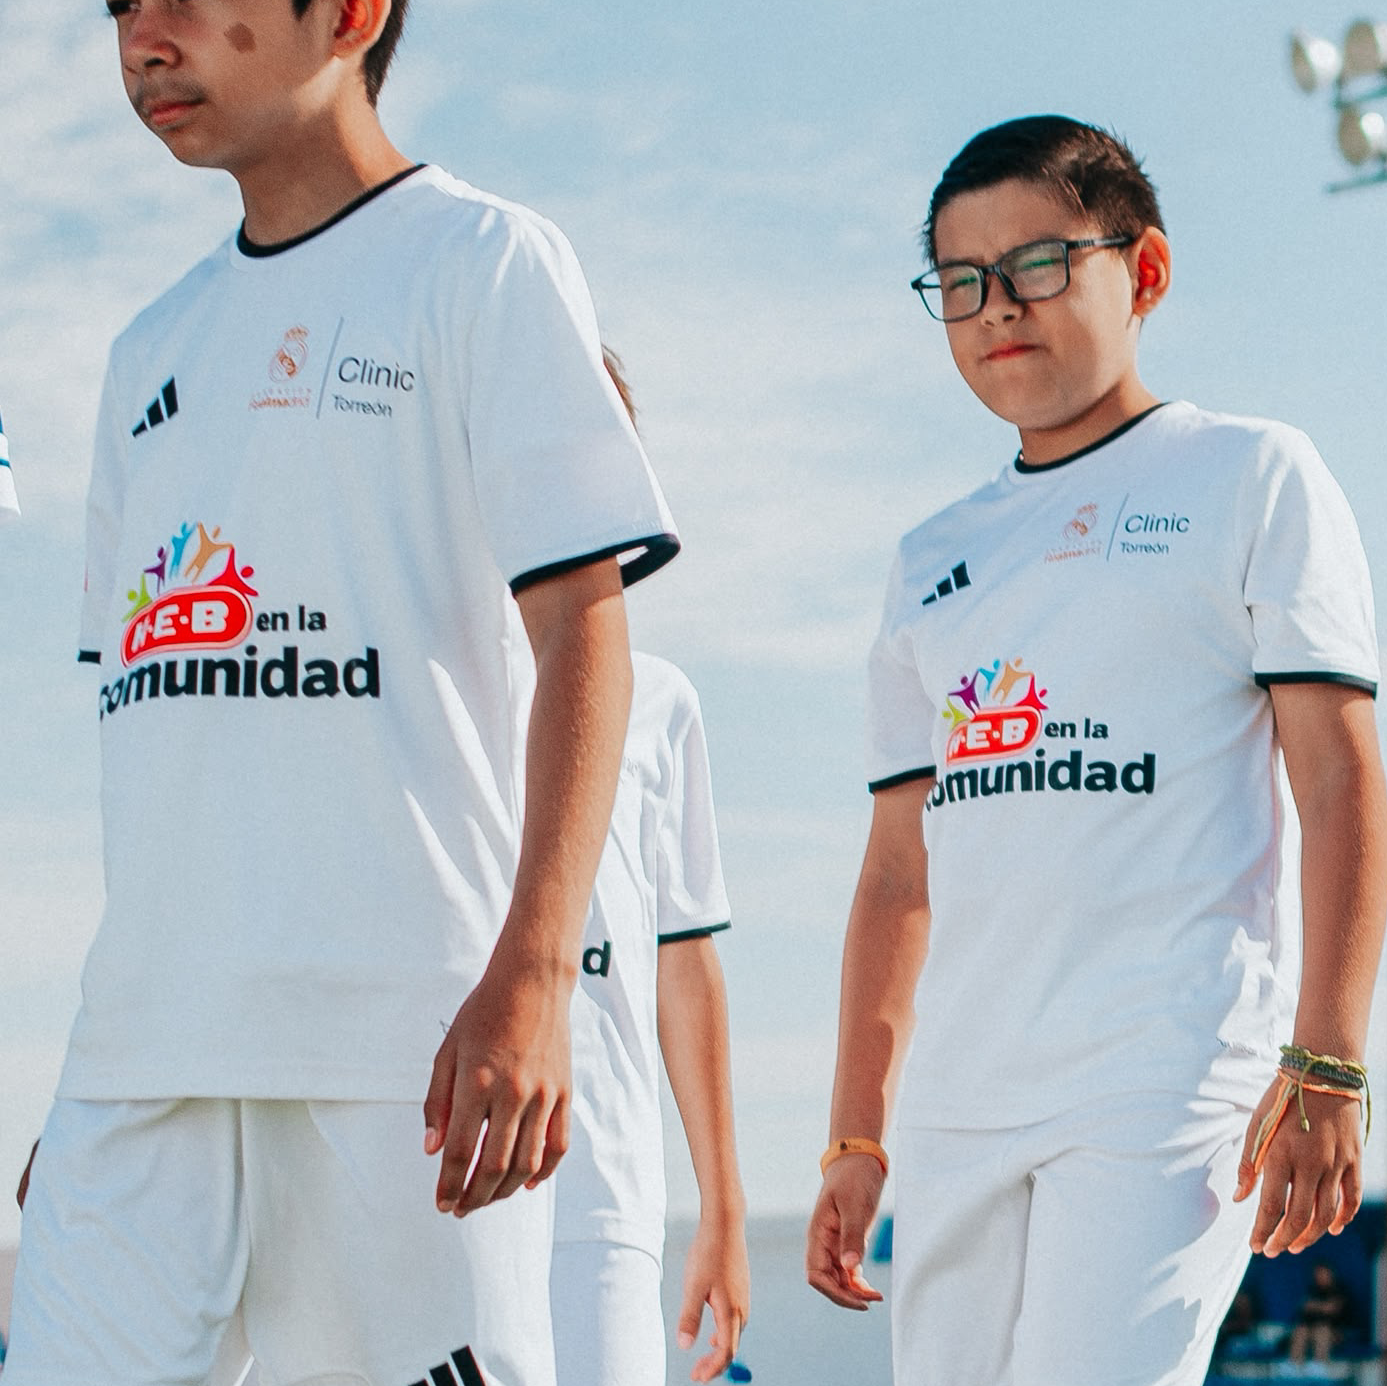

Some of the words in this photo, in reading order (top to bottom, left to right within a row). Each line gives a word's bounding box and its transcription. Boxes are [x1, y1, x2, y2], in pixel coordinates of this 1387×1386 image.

[337, 356, 415, 392] Clinic
[1124, 512, 1190, 534] Clinic
[256, 612, 289, 632] en
[299, 605, 327, 632] la
[1044, 722, 1076, 739] en
[1085, 718, 1109, 740] la
[925, 748, 1156, 812] omunidad
